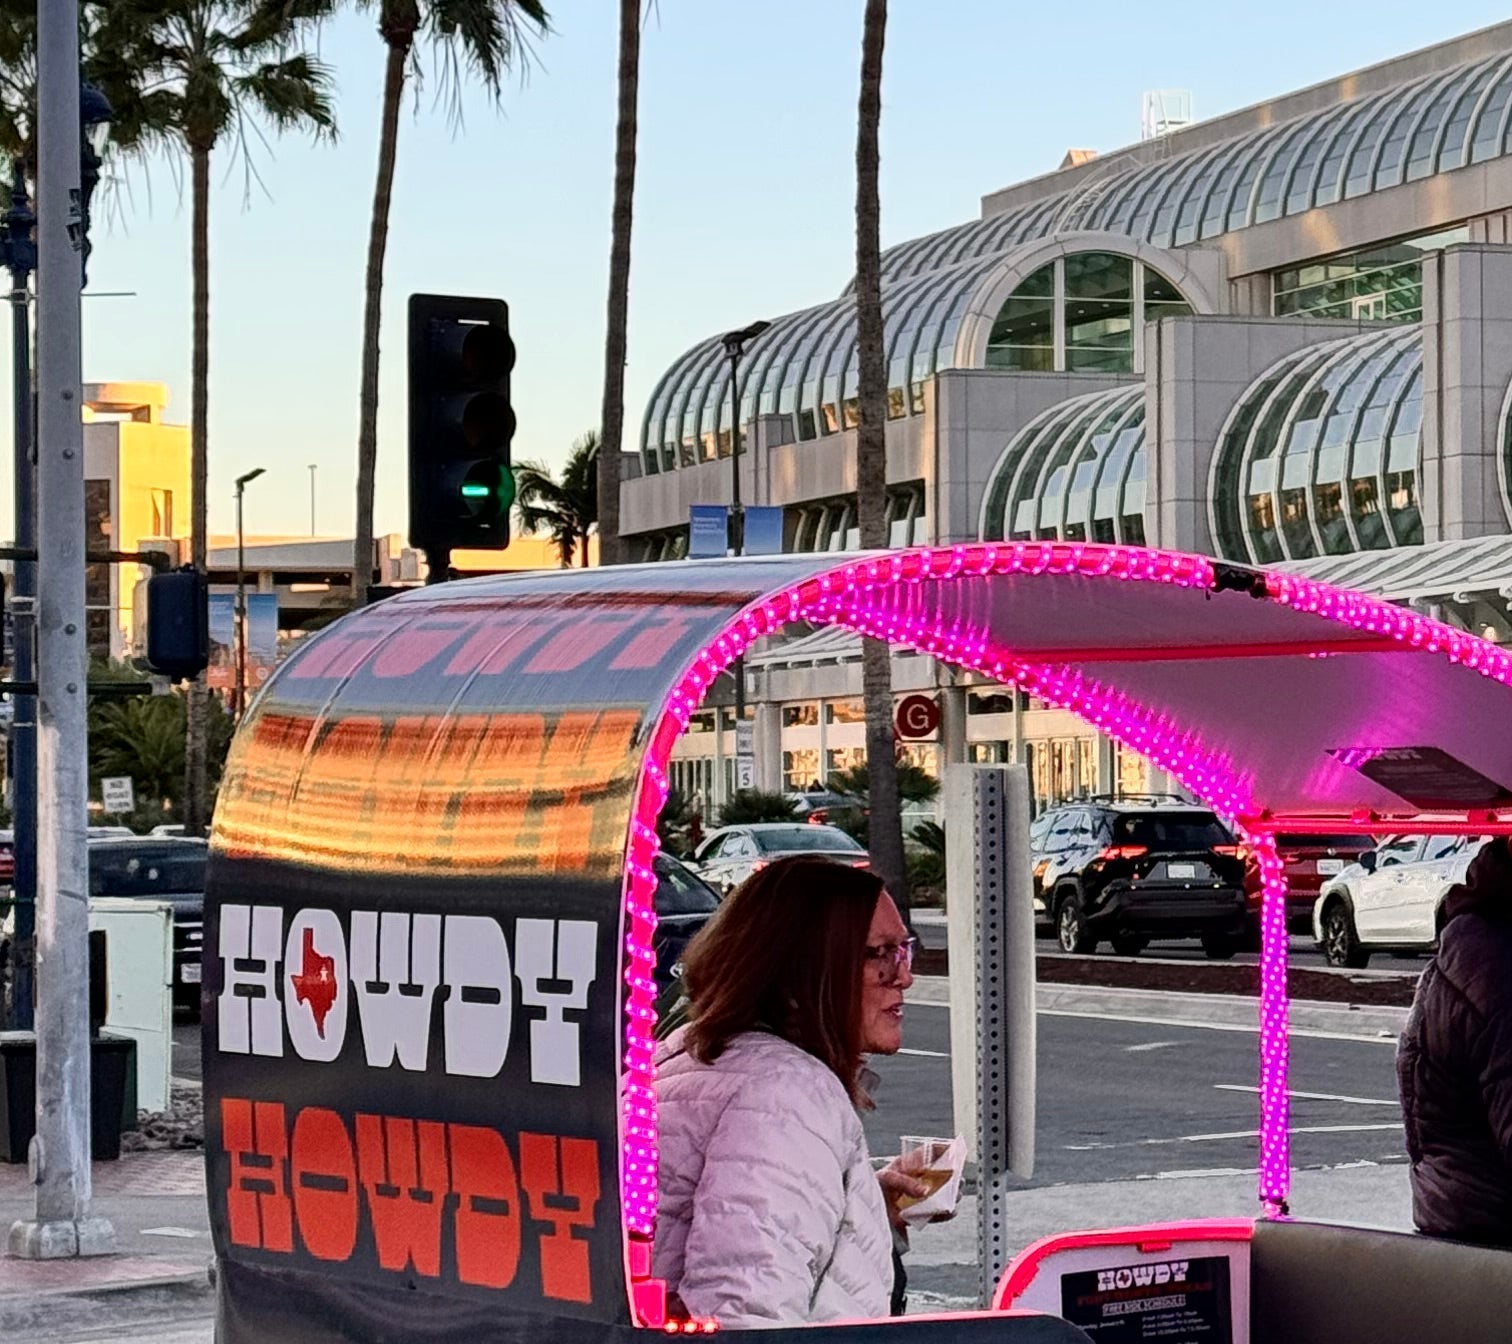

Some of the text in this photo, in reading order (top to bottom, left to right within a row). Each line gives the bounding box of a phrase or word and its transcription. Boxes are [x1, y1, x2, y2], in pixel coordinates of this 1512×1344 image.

[907, 704, 929, 730] G
[218, 904, 598, 1086] HOWDY
[220, 1098, 601, 1304] HOWDY
[1097, 1261, 1189, 1292] HOWDY
